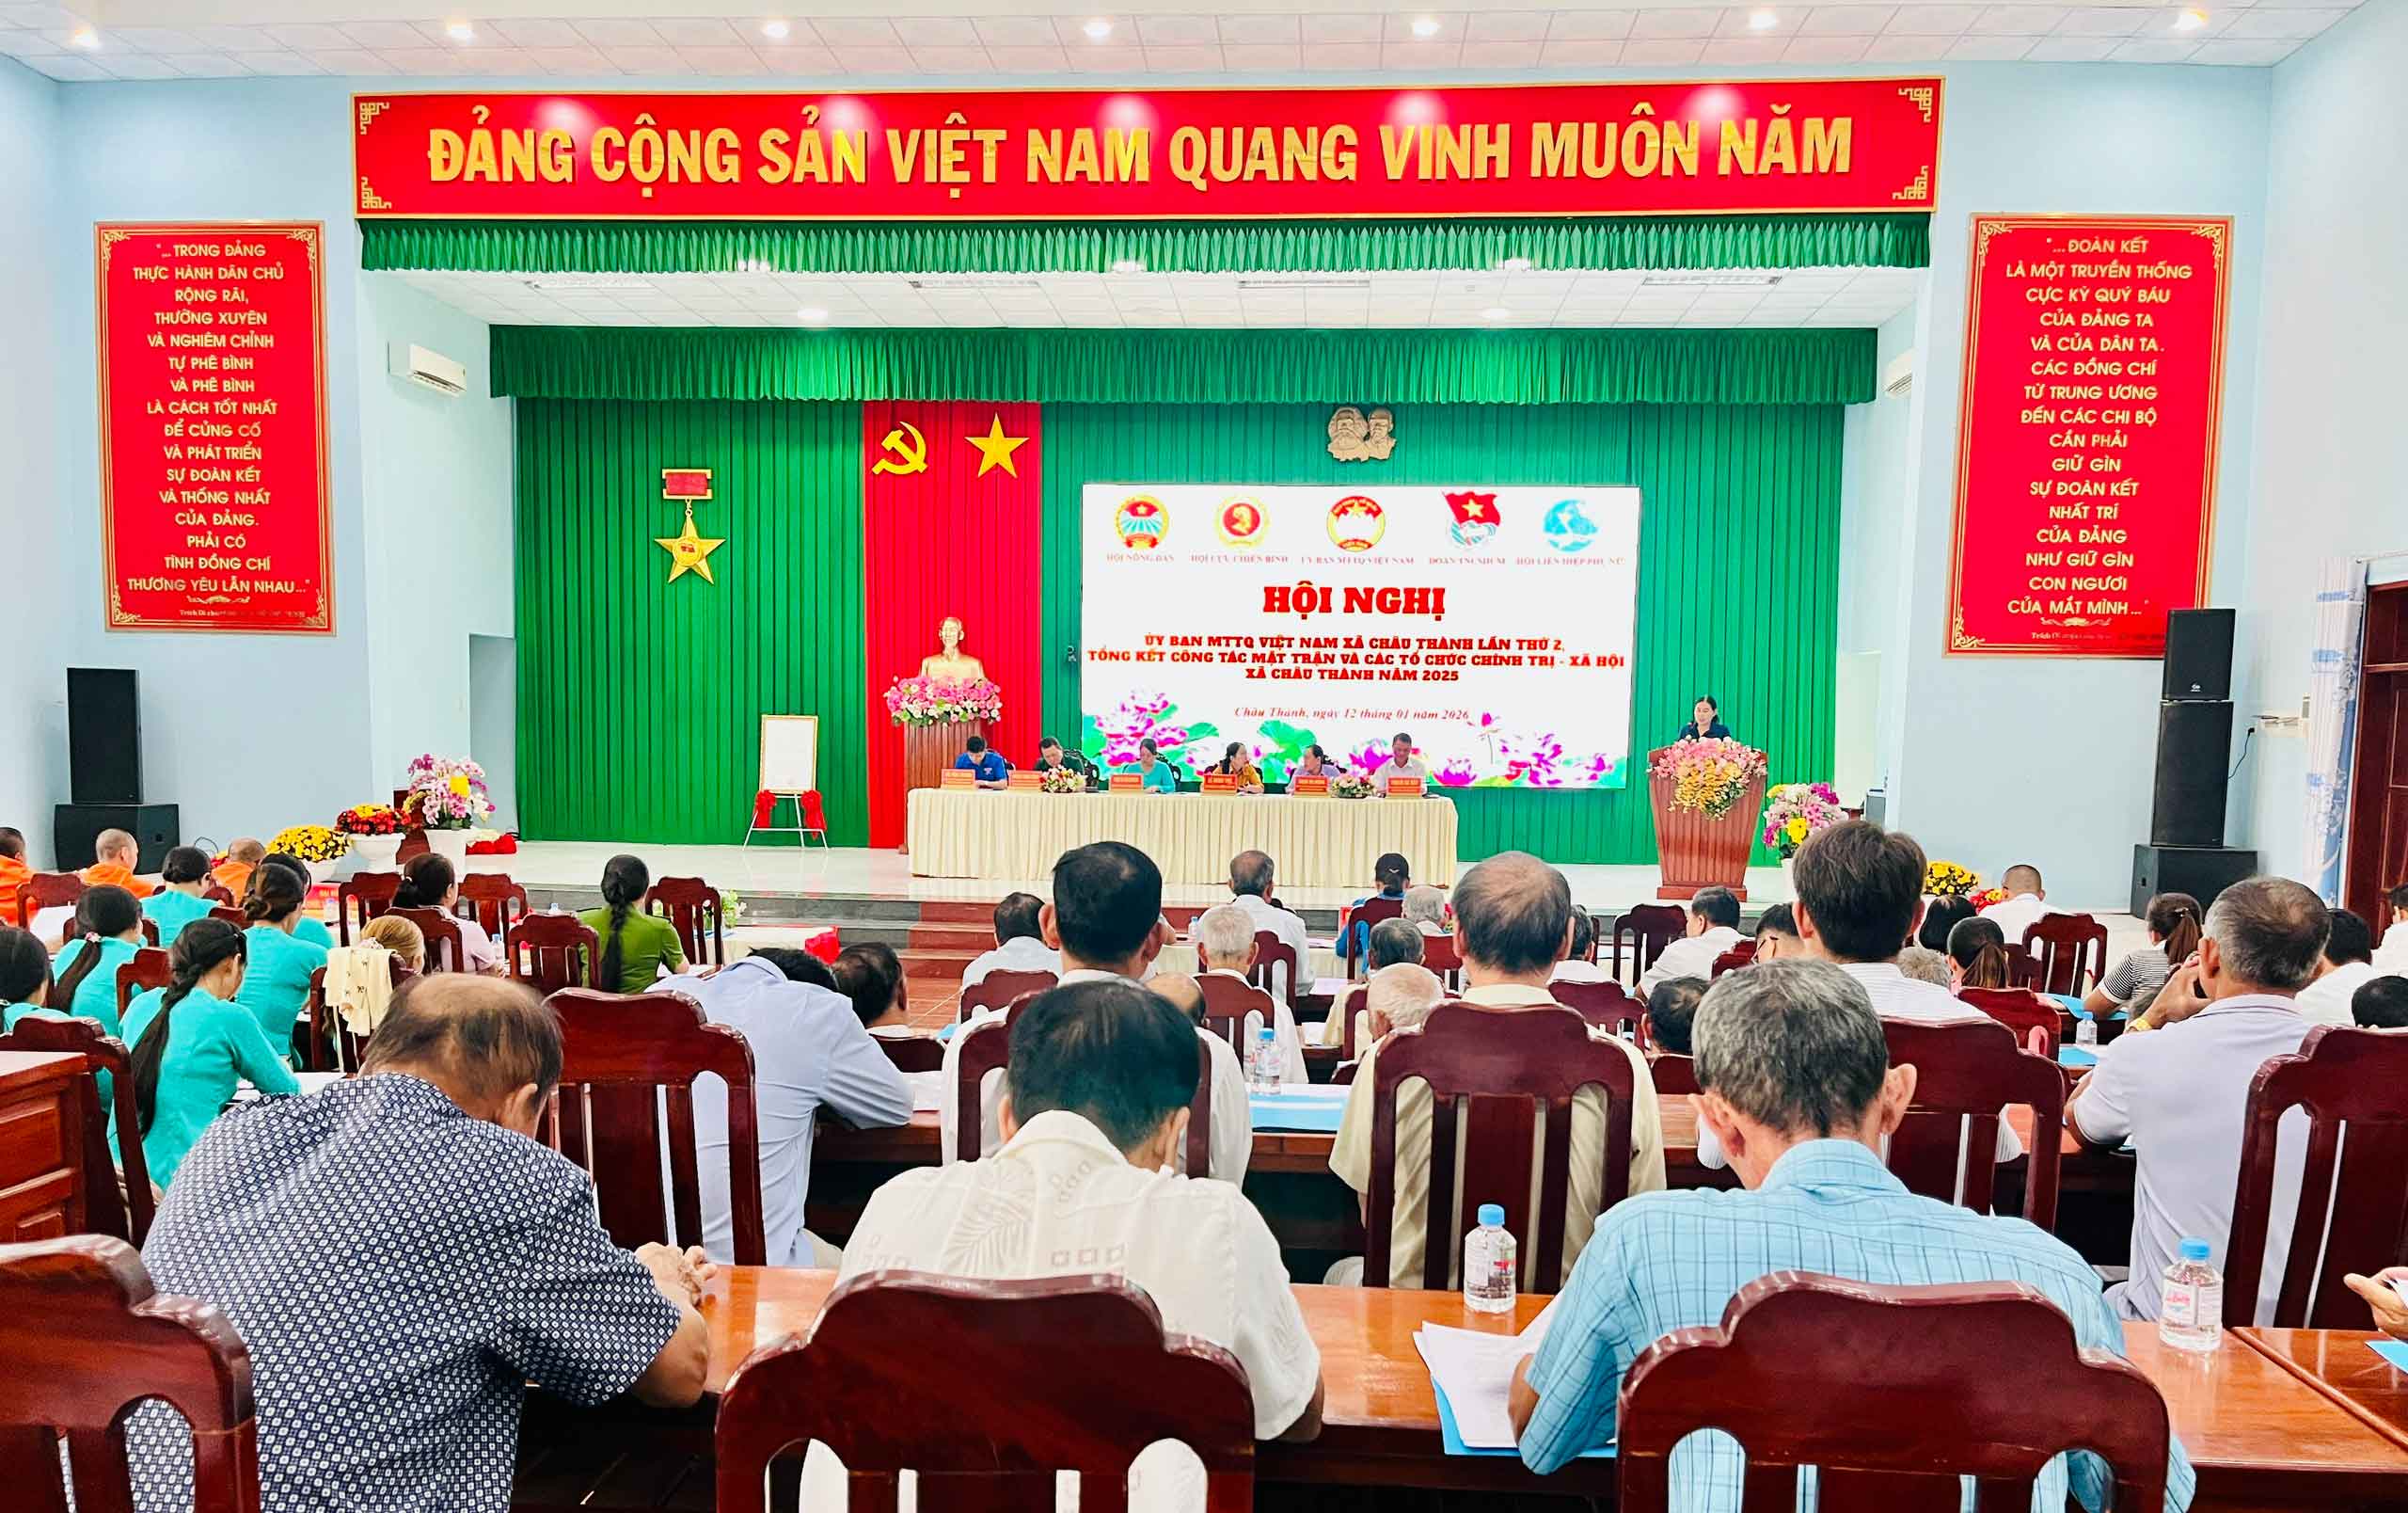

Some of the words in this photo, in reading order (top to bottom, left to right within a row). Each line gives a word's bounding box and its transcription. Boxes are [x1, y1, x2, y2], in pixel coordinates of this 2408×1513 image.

[428, 105, 575, 184] ĐẢNG
[592, 112, 741, 198] CỘNG
[757, 105, 868, 184] SẢN
[886, 112, 1007, 198] VIỆT
[1026, 126, 1150, 183] NAM
[1168, 122, 1358, 192] QUANG
[1379, 120, 1510, 181] VINH
[1530, 102, 1701, 180] MUÔN
[1718, 103, 1853, 176] NĂM
[225, 240, 265, 256] ĐẢNG
[2121, 236, 2148, 252] KẾT
[134, 265, 168, 282] THỰC
[175, 264, 213, 279] HÀNH
[253, 263, 283, 279] CHỦ
[2006, 261, 2025, 277] LÀ
[2031, 261, 2065, 280] MỘT
[2071, 260, 2131, 278] TRUYỀN
[2137, 261, 2192, 279] THỐNG
[2026, 286, 2062, 305] CỰC
[2069, 286, 2089, 301] KỲ
[2095, 286, 2131, 302] QUÝ
[2138, 286, 2170, 303] BÁU
[155, 309, 213, 324] THƯỜNG
[219, 311, 267, 325] XUYÊN
[2040, 309, 2075, 326] CỦA
[2082, 309, 2130, 326] ĐẢNG
[2136, 313, 2153, 326] TA
[148, 332, 166, 346] VÀ
[170, 332, 226, 347] NGHIÊM
[2031, 335, 2052, 351] VÀ
[2057, 333, 2093, 351] CỦA
[168, 356, 185, 372] TỰ
[191, 355, 218, 369] PHÊ
[223, 355, 253, 369] BÌNH
[2032, 359, 2067, 374] CÁC
[2074, 358, 2122, 375] ĐỒNG
[2128, 359, 2157, 375] CHÍ
[170, 377, 188, 391] VÀ
[193, 377, 218, 391] PHÊ
[223, 377, 254, 391] BÌNH
[2024, 383, 2045, 399] TỪ
[2050, 386, 2102, 399] TRUNG
[2109, 384, 2158, 400] ƯƠNG
[148, 400, 164, 413] LÀ
[168, 400, 209, 414] CÁCH
[214, 399, 237, 414] TỐT
[243, 399, 277, 414] NHẤT
[2021, 406, 2055, 423] ĐẾN
[2060, 407, 2097, 423] CÁC
[2101, 410, 2130, 423] CHI
[2135, 407, 2157, 426] BỘ
[165, 419, 183, 437] ĐỂ
[188, 421, 232, 437] CỦNG
[238, 422, 261, 437] CỐ
[2092, 430, 2127, 447] PHẢI
[164, 444, 182, 459] VÀ
[187, 444, 221, 459] PHÁT
[225, 441, 261, 459] TRIỂN
[2052, 454, 2083, 471] GIỮ
[2090, 455, 2121, 471] GÌN
[167, 468, 185, 484] SỰ
[190, 467, 230, 482] ĐOÀN
[236, 466, 261, 482] KẾT
[159, 488, 177, 502] VÀ
[181, 487, 229, 503] THỐNG
[235, 488, 270, 504] NHẤT
[2031, 480, 2052, 498] SỰ
[2057, 480, 2105, 496] ĐOÀN
[2111, 478, 2139, 496] KẾT
[175, 509, 207, 525] CỦA
[2050, 502, 2090, 518] NHẤT
[2097, 503, 2118, 519] TRÍ
[187, 532, 219, 548] PHẢI
[224, 534, 246, 549] CÓ
[2036, 525, 2072, 543] CỦA
[2079, 525, 2127, 543] ĐẢNG
[165, 555, 194, 568] TÌNH
[198, 554, 241, 569] ĐỒNG
[246, 557, 270, 570] CHÍ
[2026, 551, 2062, 565] NHƯ
[2067, 550, 2098, 566] GIỮ
[2102, 551, 2133, 566] GÌN
[128, 577, 185, 591] THƯƠNG
[191, 577, 217, 591] YÊU
[2029, 577, 2066, 590] CON
[1263, 580, 1332, 620] HỘI
[1343, 587, 1445, 621] NGHỊ
[2008, 597, 2042, 613] CỦA
[1169, 635, 1203, 647] BAN
[1207, 636, 1254, 649] MTTQ
[1259, 634, 1294, 649] VIỆT
[1300, 637, 1339, 650] NAM
[1342, 635, 1364, 650] XÃ
[1369, 636, 1411, 649] CHÂU
[1416, 636, 1473, 652] THÀNH
[1087, 645, 1131, 662] TỔNG
[1135, 647, 1166, 662] KẾT
[1171, 649, 1213, 663] CÔNG
[1219, 650, 1247, 664] TÁC
[1252, 651, 1287, 666] MẶT
[1291, 652, 1336, 666] TRẬN
[1340, 652, 1360, 665] VÀ
[1364, 652, 1395, 666] CÁC
[1400, 649, 1420, 665] TỔ
[1425, 653, 1466, 666] CHỨC
[1471, 653, 1523, 667] CHÍNH
[1529, 655, 1555, 670] TRỊ
[1569, 653, 1592, 667] XÃ
[1596, 653, 1625, 670] HỘI
[1245, 665, 1266, 678] XÃ
[1271, 666, 1313, 679] CHÂU
[1316, 665, 1374, 680] THÀNH
[1379, 667, 1418, 681] NĂM
[1421, 670, 1459, 681] 2025
[1234, 707, 1265, 718] Châu
[1313, 709, 1339, 721] ngày
[1343, 708, 1356, 719] 12
[1360, 708, 1393, 721] tháng
[1396, 709, 1410, 720] 01
[1413, 709, 1438, 720] năm
[1441, 709, 1470, 721] 2026
